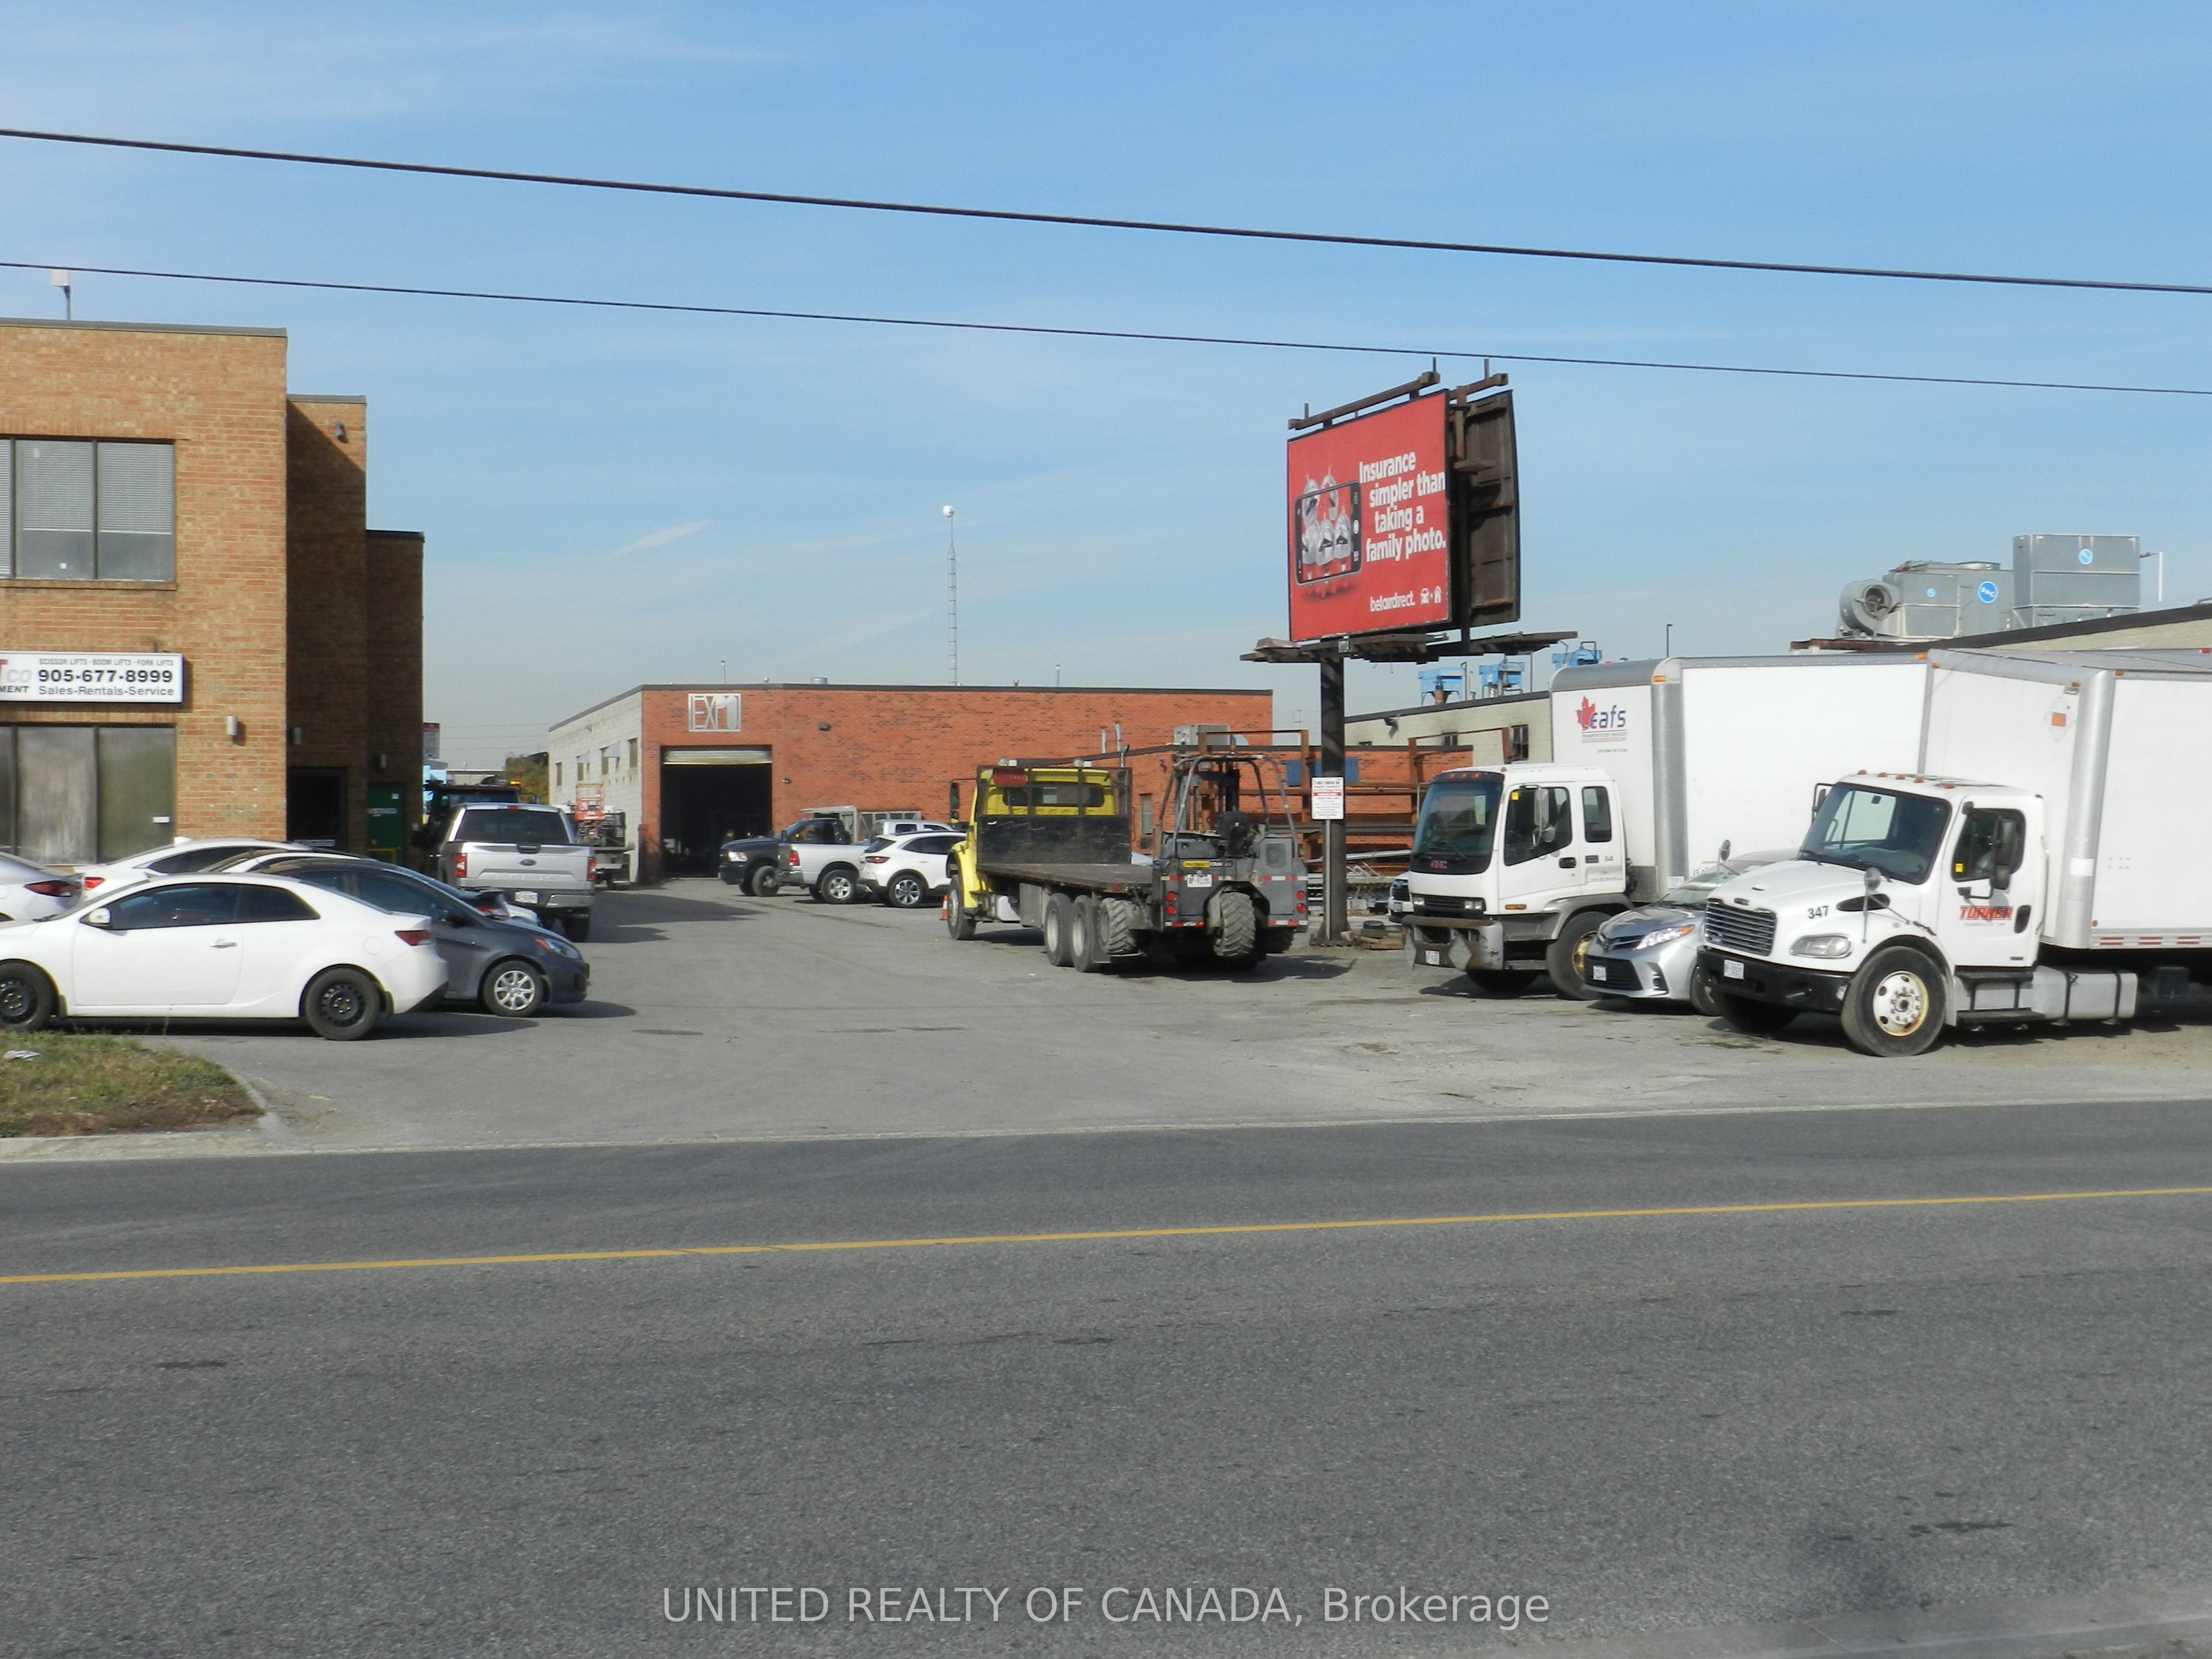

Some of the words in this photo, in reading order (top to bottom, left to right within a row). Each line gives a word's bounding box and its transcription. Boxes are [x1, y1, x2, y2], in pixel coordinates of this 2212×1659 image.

[1359, 452, 1416, 484] Insurance
[1369, 477, 1414, 508] simpler
[1416, 470, 1446, 497] than
[1374, 505, 1413, 534] taking
[1416, 505, 1424, 525] a
[1366, 533, 1402, 562] family
[1406, 527, 1446, 560] photo.
[38, 669, 173, 683] 905-677-8999
[38, 686, 174, 695] Sales-Rentals-Service
[1808, 906, 1828, 919] 347
[1960, 906, 2013, 920] TURNER
